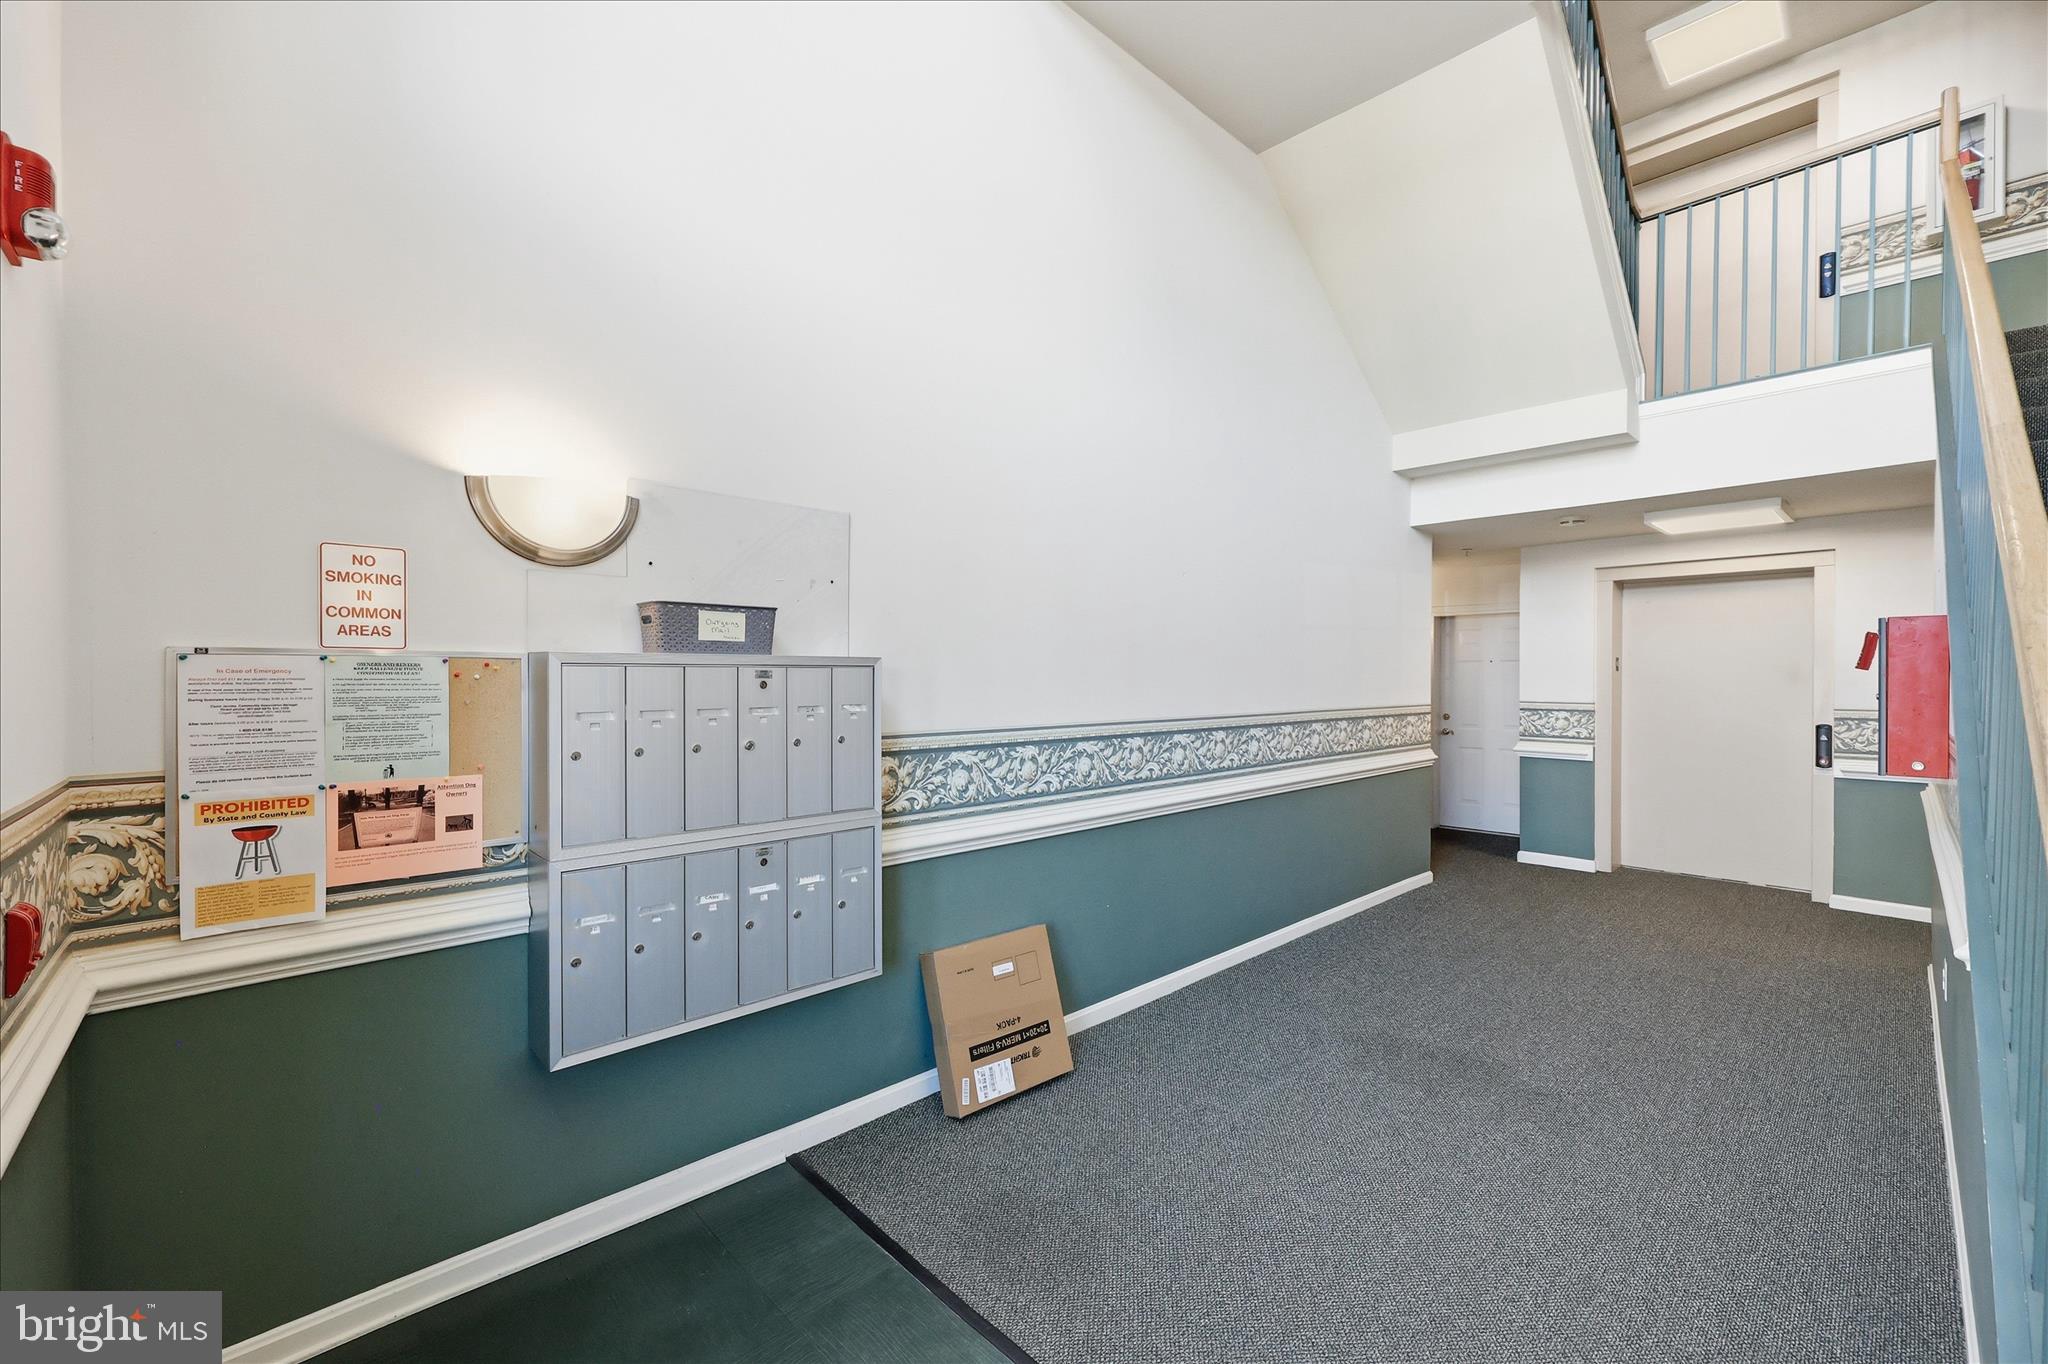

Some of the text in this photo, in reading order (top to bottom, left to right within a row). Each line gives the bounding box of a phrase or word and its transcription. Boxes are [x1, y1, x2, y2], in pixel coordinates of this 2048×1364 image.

[14, 160, 24, 192] FIRE
[352, 554, 376, 567] NO
[325, 570, 402, 586] SMOKING
[357, 589, 372, 602] IN
[325, 605, 402, 620] COMMON
[337, 624, 392, 637] AREAS
[200, 797, 310, 816] PROHIBITED
[216, 815, 239, 823] State
[240, 813, 257, 821] and
[258, 811, 289, 819] County
[972, 1042, 995, 1056] Filters
